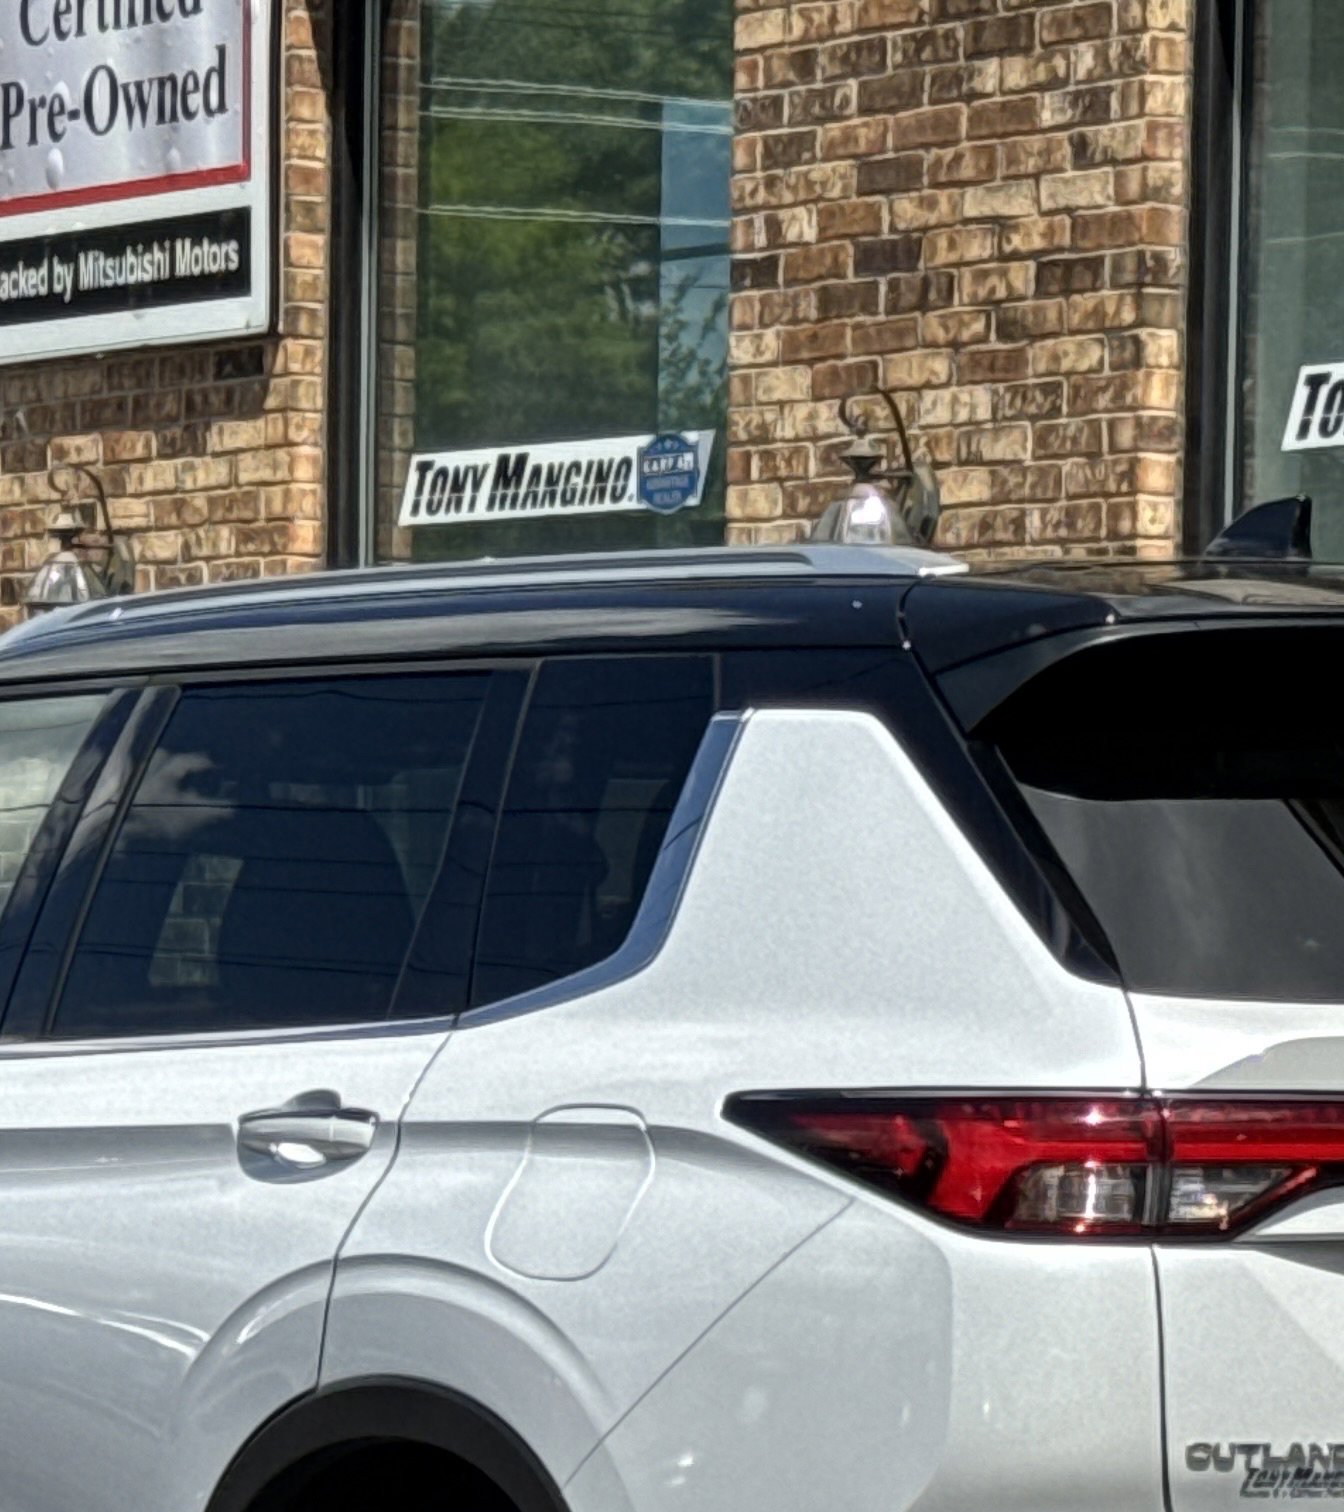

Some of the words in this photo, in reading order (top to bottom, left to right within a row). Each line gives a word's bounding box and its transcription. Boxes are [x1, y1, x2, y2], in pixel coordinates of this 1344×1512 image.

[0, 44, 228, 151] Pre-Owned
[52, 257, 74, 303] by
[78, 238, 171, 292] Mitsubishi
[175, 236, 239, 277] Motors
[409, 460, 490, 517] TONY
